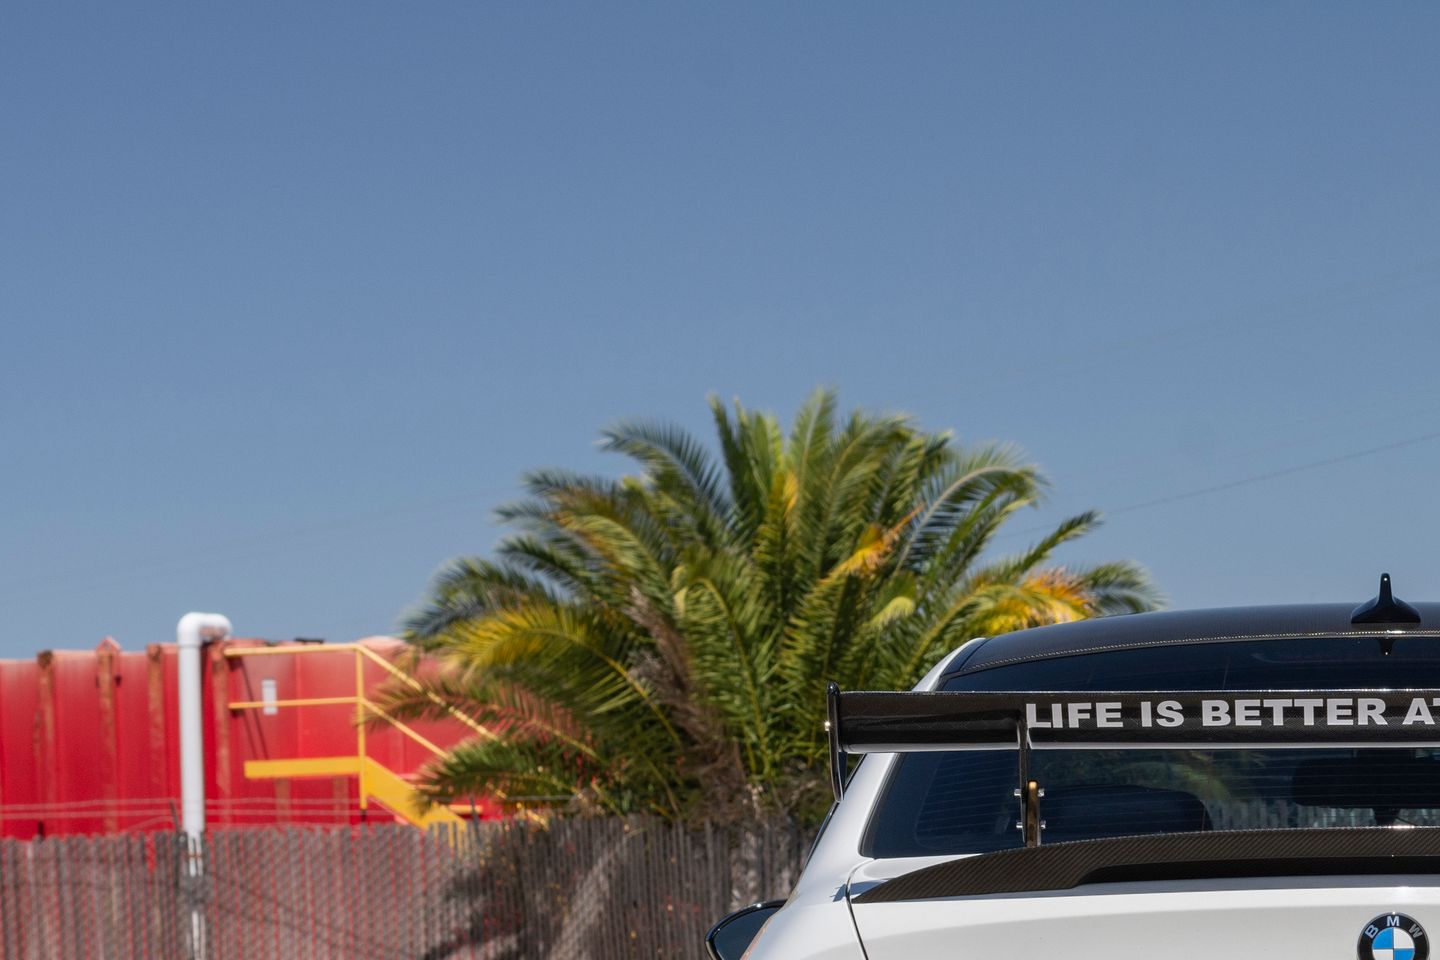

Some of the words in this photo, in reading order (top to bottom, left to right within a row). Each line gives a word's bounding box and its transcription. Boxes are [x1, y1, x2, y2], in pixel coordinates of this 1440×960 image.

[1026, 702, 1123, 729] LIFE
[1140, 700, 1185, 728] IS
[1201, 698, 1388, 727] BETTER
[1364, 915, 1423, 939] BMW
